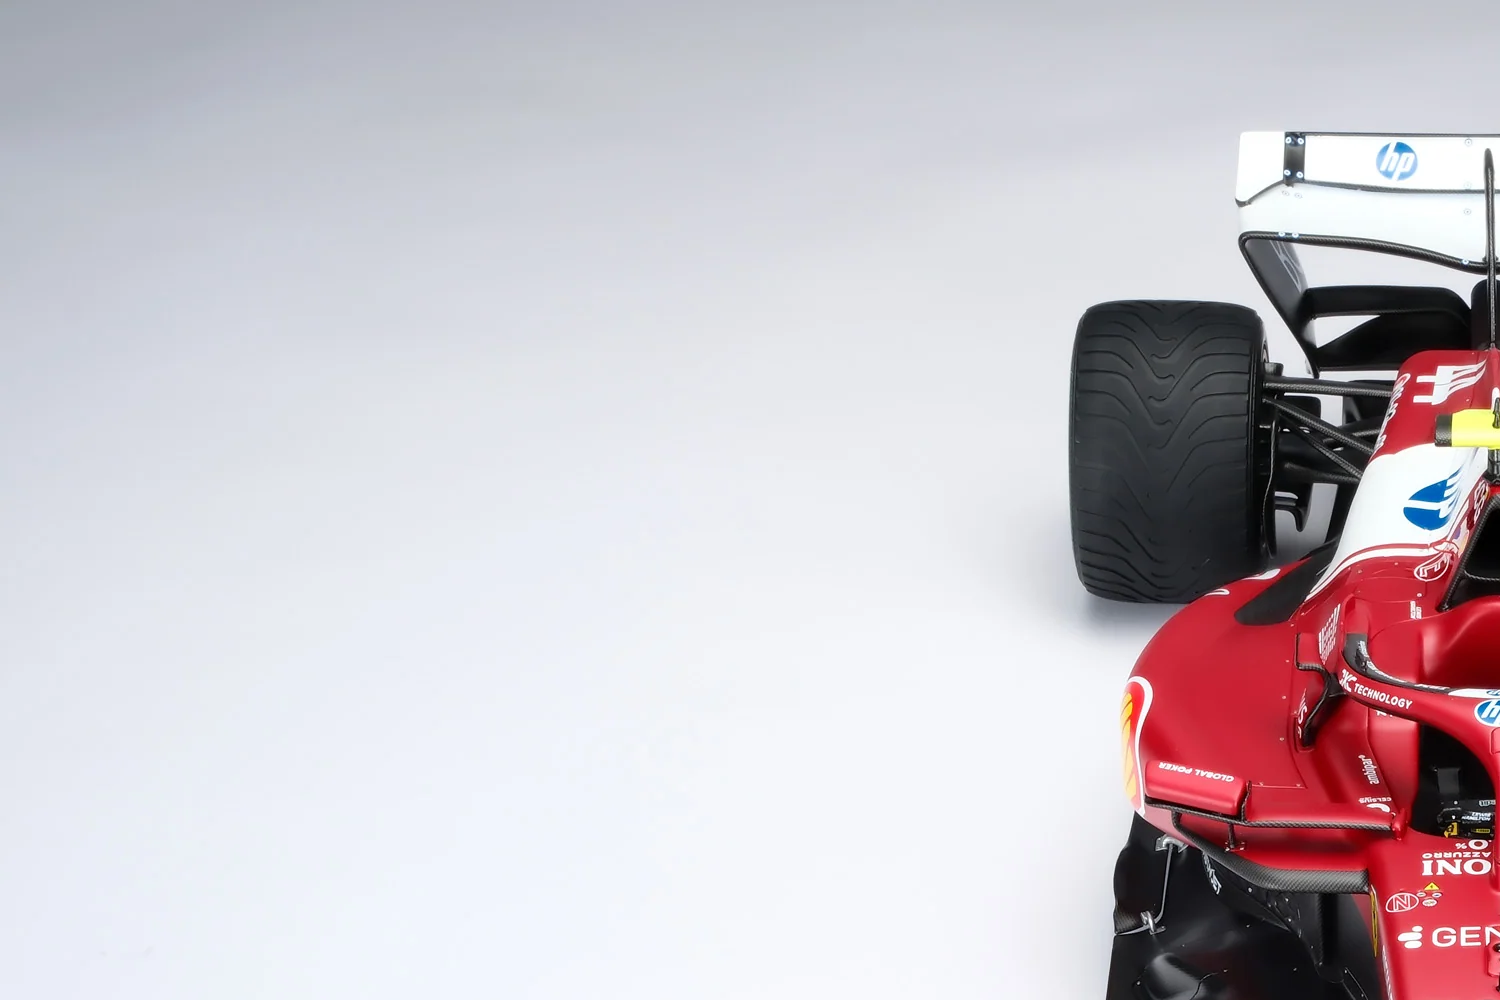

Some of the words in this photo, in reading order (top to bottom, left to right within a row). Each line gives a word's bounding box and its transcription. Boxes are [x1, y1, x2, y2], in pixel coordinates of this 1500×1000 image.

[1380, 141, 1417, 181] hp
[1354, 682, 1413, 709] TECHNOLOGY
[1158, 761, 1193, 774] POKER
[1194, 770, 1234, 783] GLOBAL
[1422, 851, 1492, 859] AZZURRO
